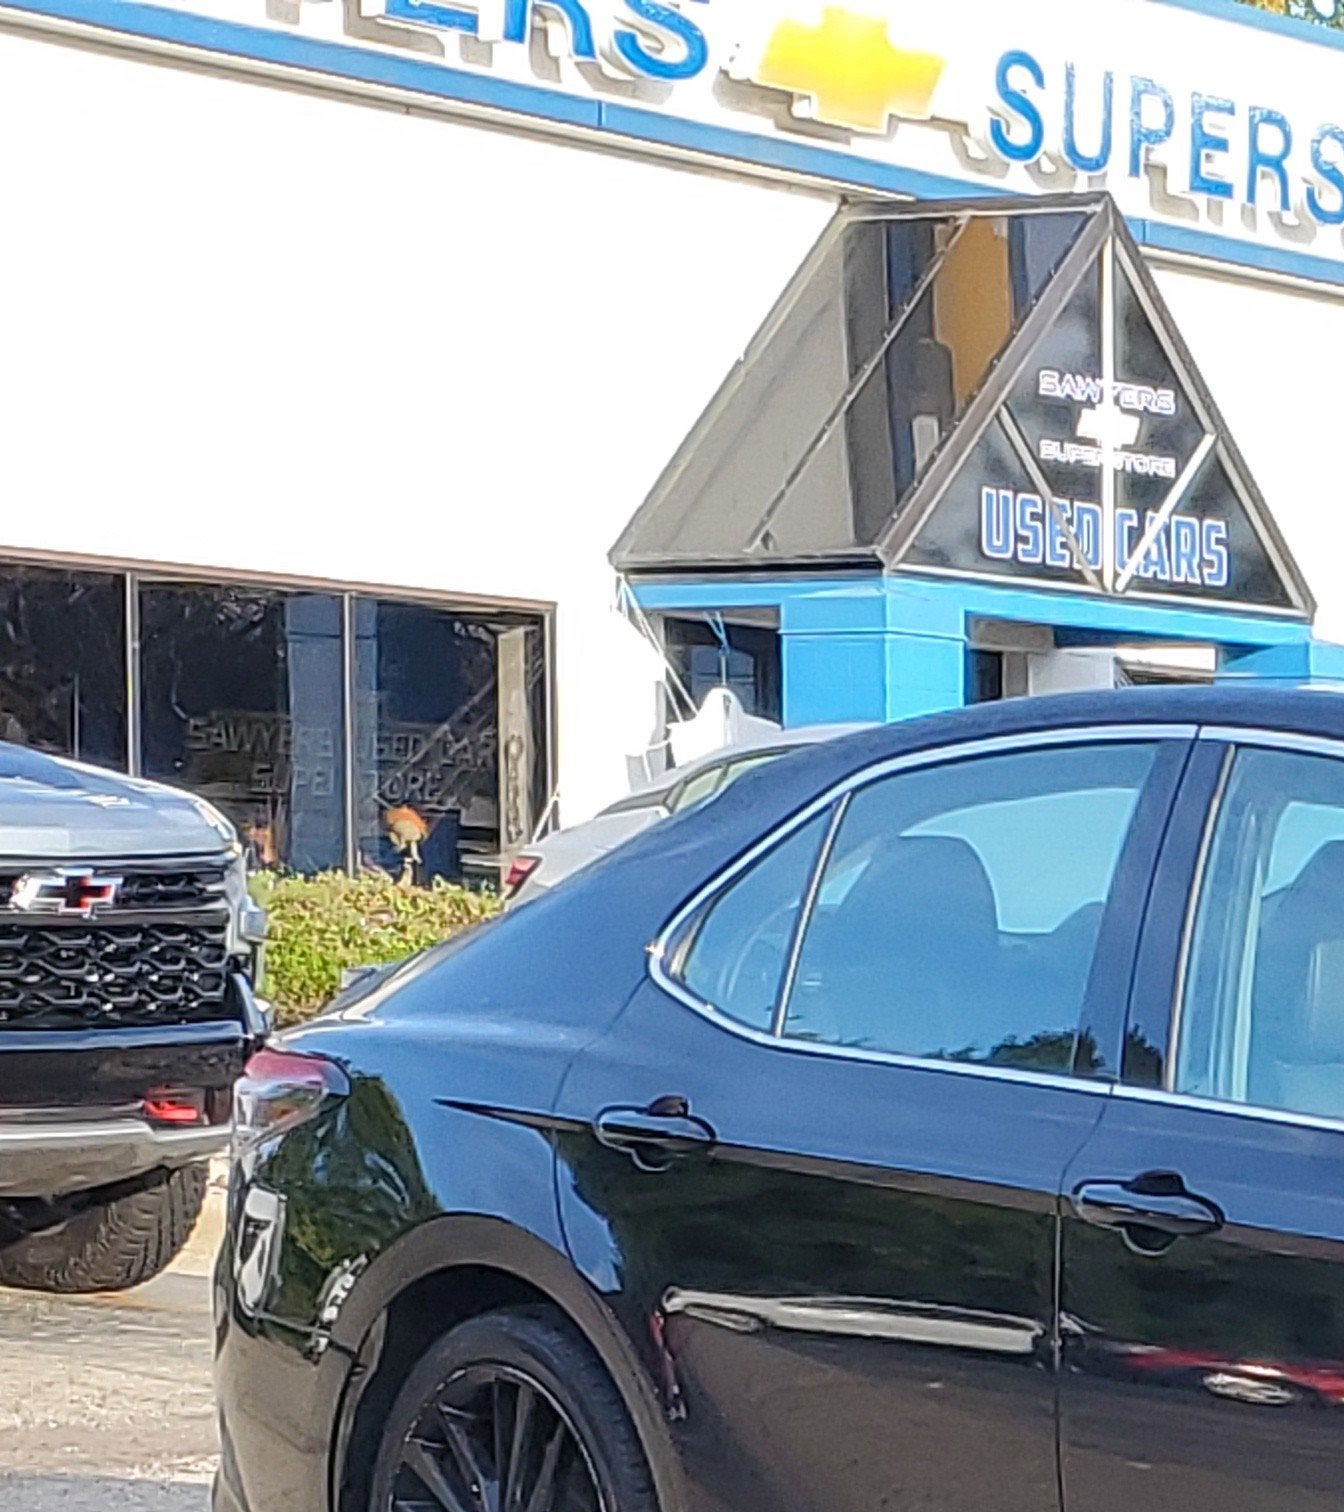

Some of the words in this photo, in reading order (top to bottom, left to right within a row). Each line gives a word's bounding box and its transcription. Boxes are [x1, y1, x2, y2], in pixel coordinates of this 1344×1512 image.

[1038, 438, 1176, 478] SUPESTORE
[980, 487, 1102, 568] USED
[1114, 508, 1229, 587] CARS
